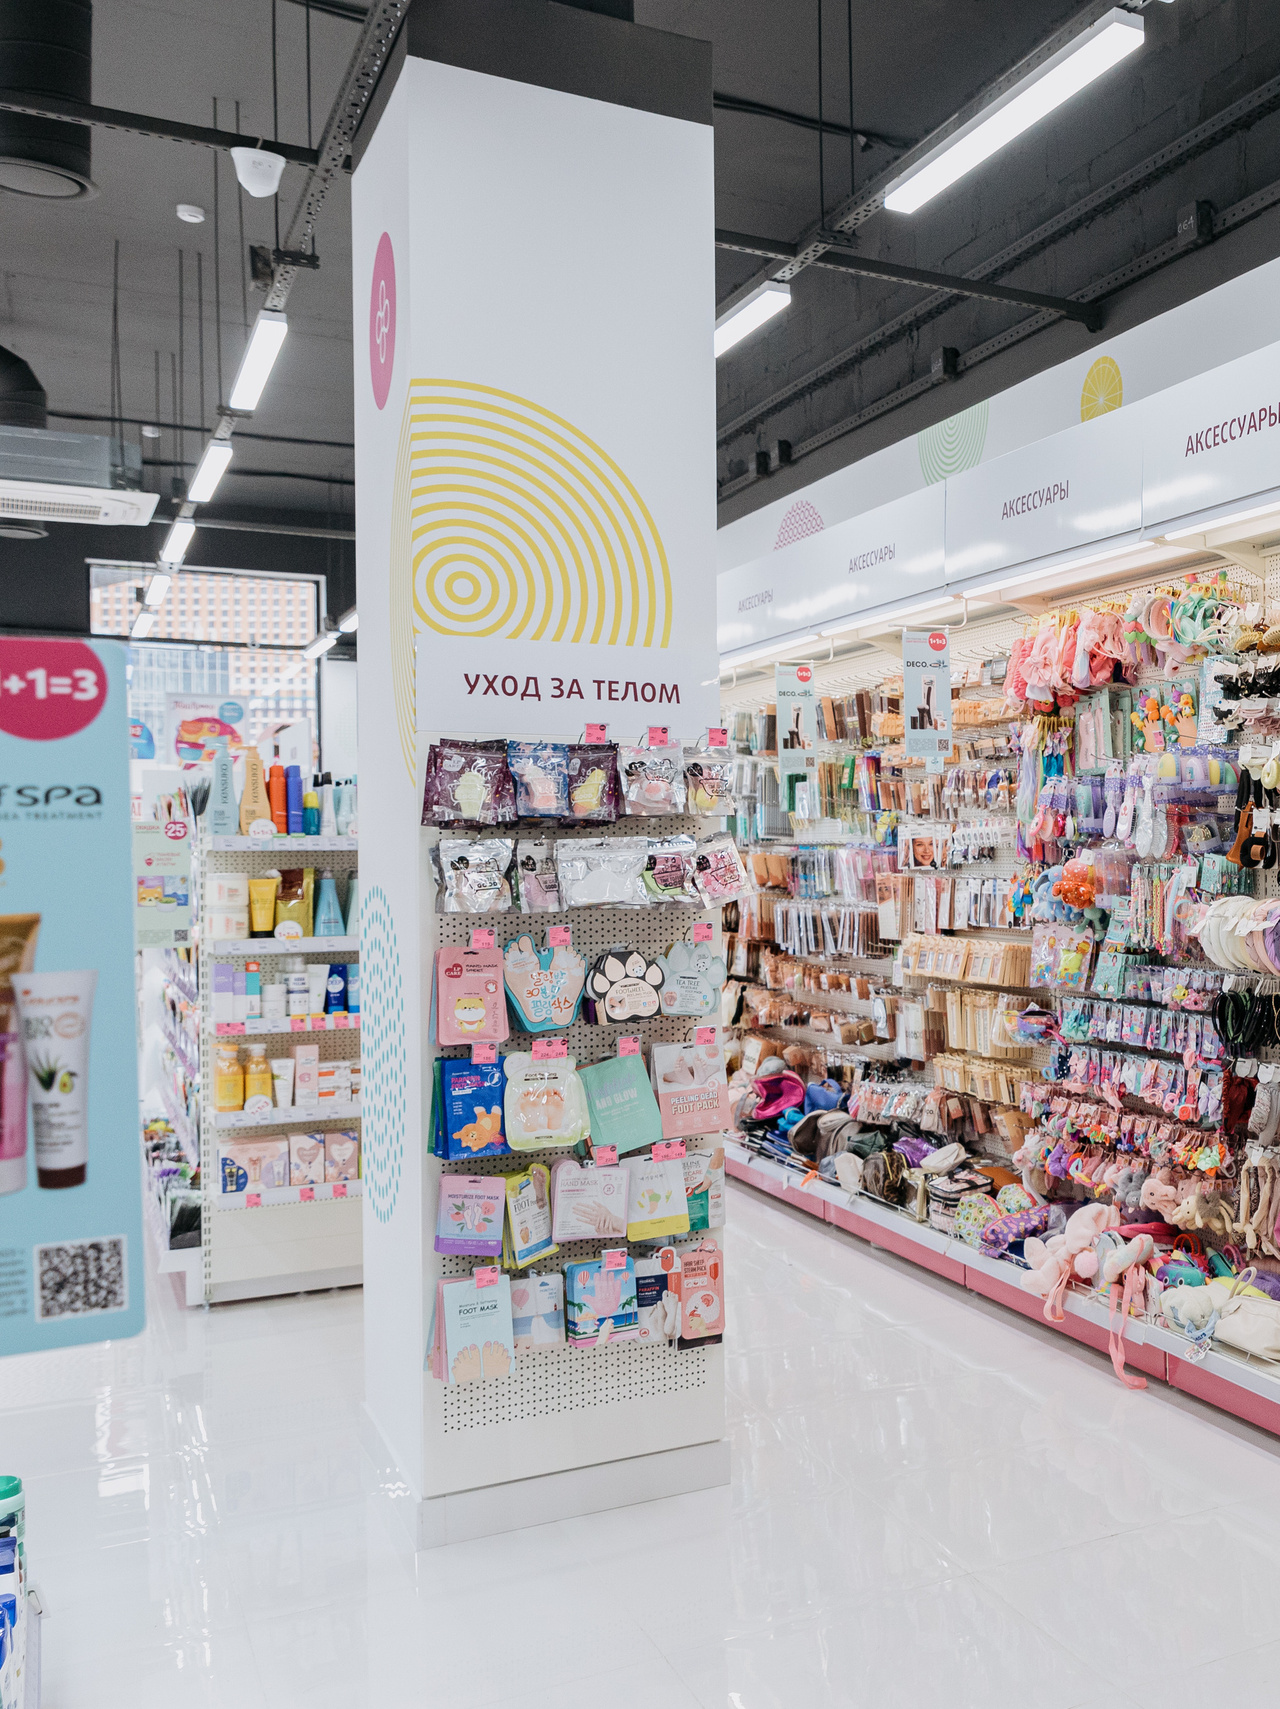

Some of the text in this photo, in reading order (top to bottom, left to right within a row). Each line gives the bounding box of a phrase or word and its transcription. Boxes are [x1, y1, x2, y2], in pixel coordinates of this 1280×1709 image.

[1002, 480, 1070, 520] АКСЕССУАРЫ
[848, 543, 896, 574] АКСЕССУАРЫ
[738, 588, 774, 614] АКСЕССУАРЫ
[906, 660, 929, 668] DECO.
[0, 668, 99, 700] +1=3
[463, 673, 681, 705] УХОД ЗА ТЕЛОМ
[613, 1088, 638, 1104] GLOW
[670, 1090, 718, 1105] PEELING DEAD
[672, 1100, 720, 1115] FOOT PACK
[459, 1304, 498, 1316] FOOT MASK
